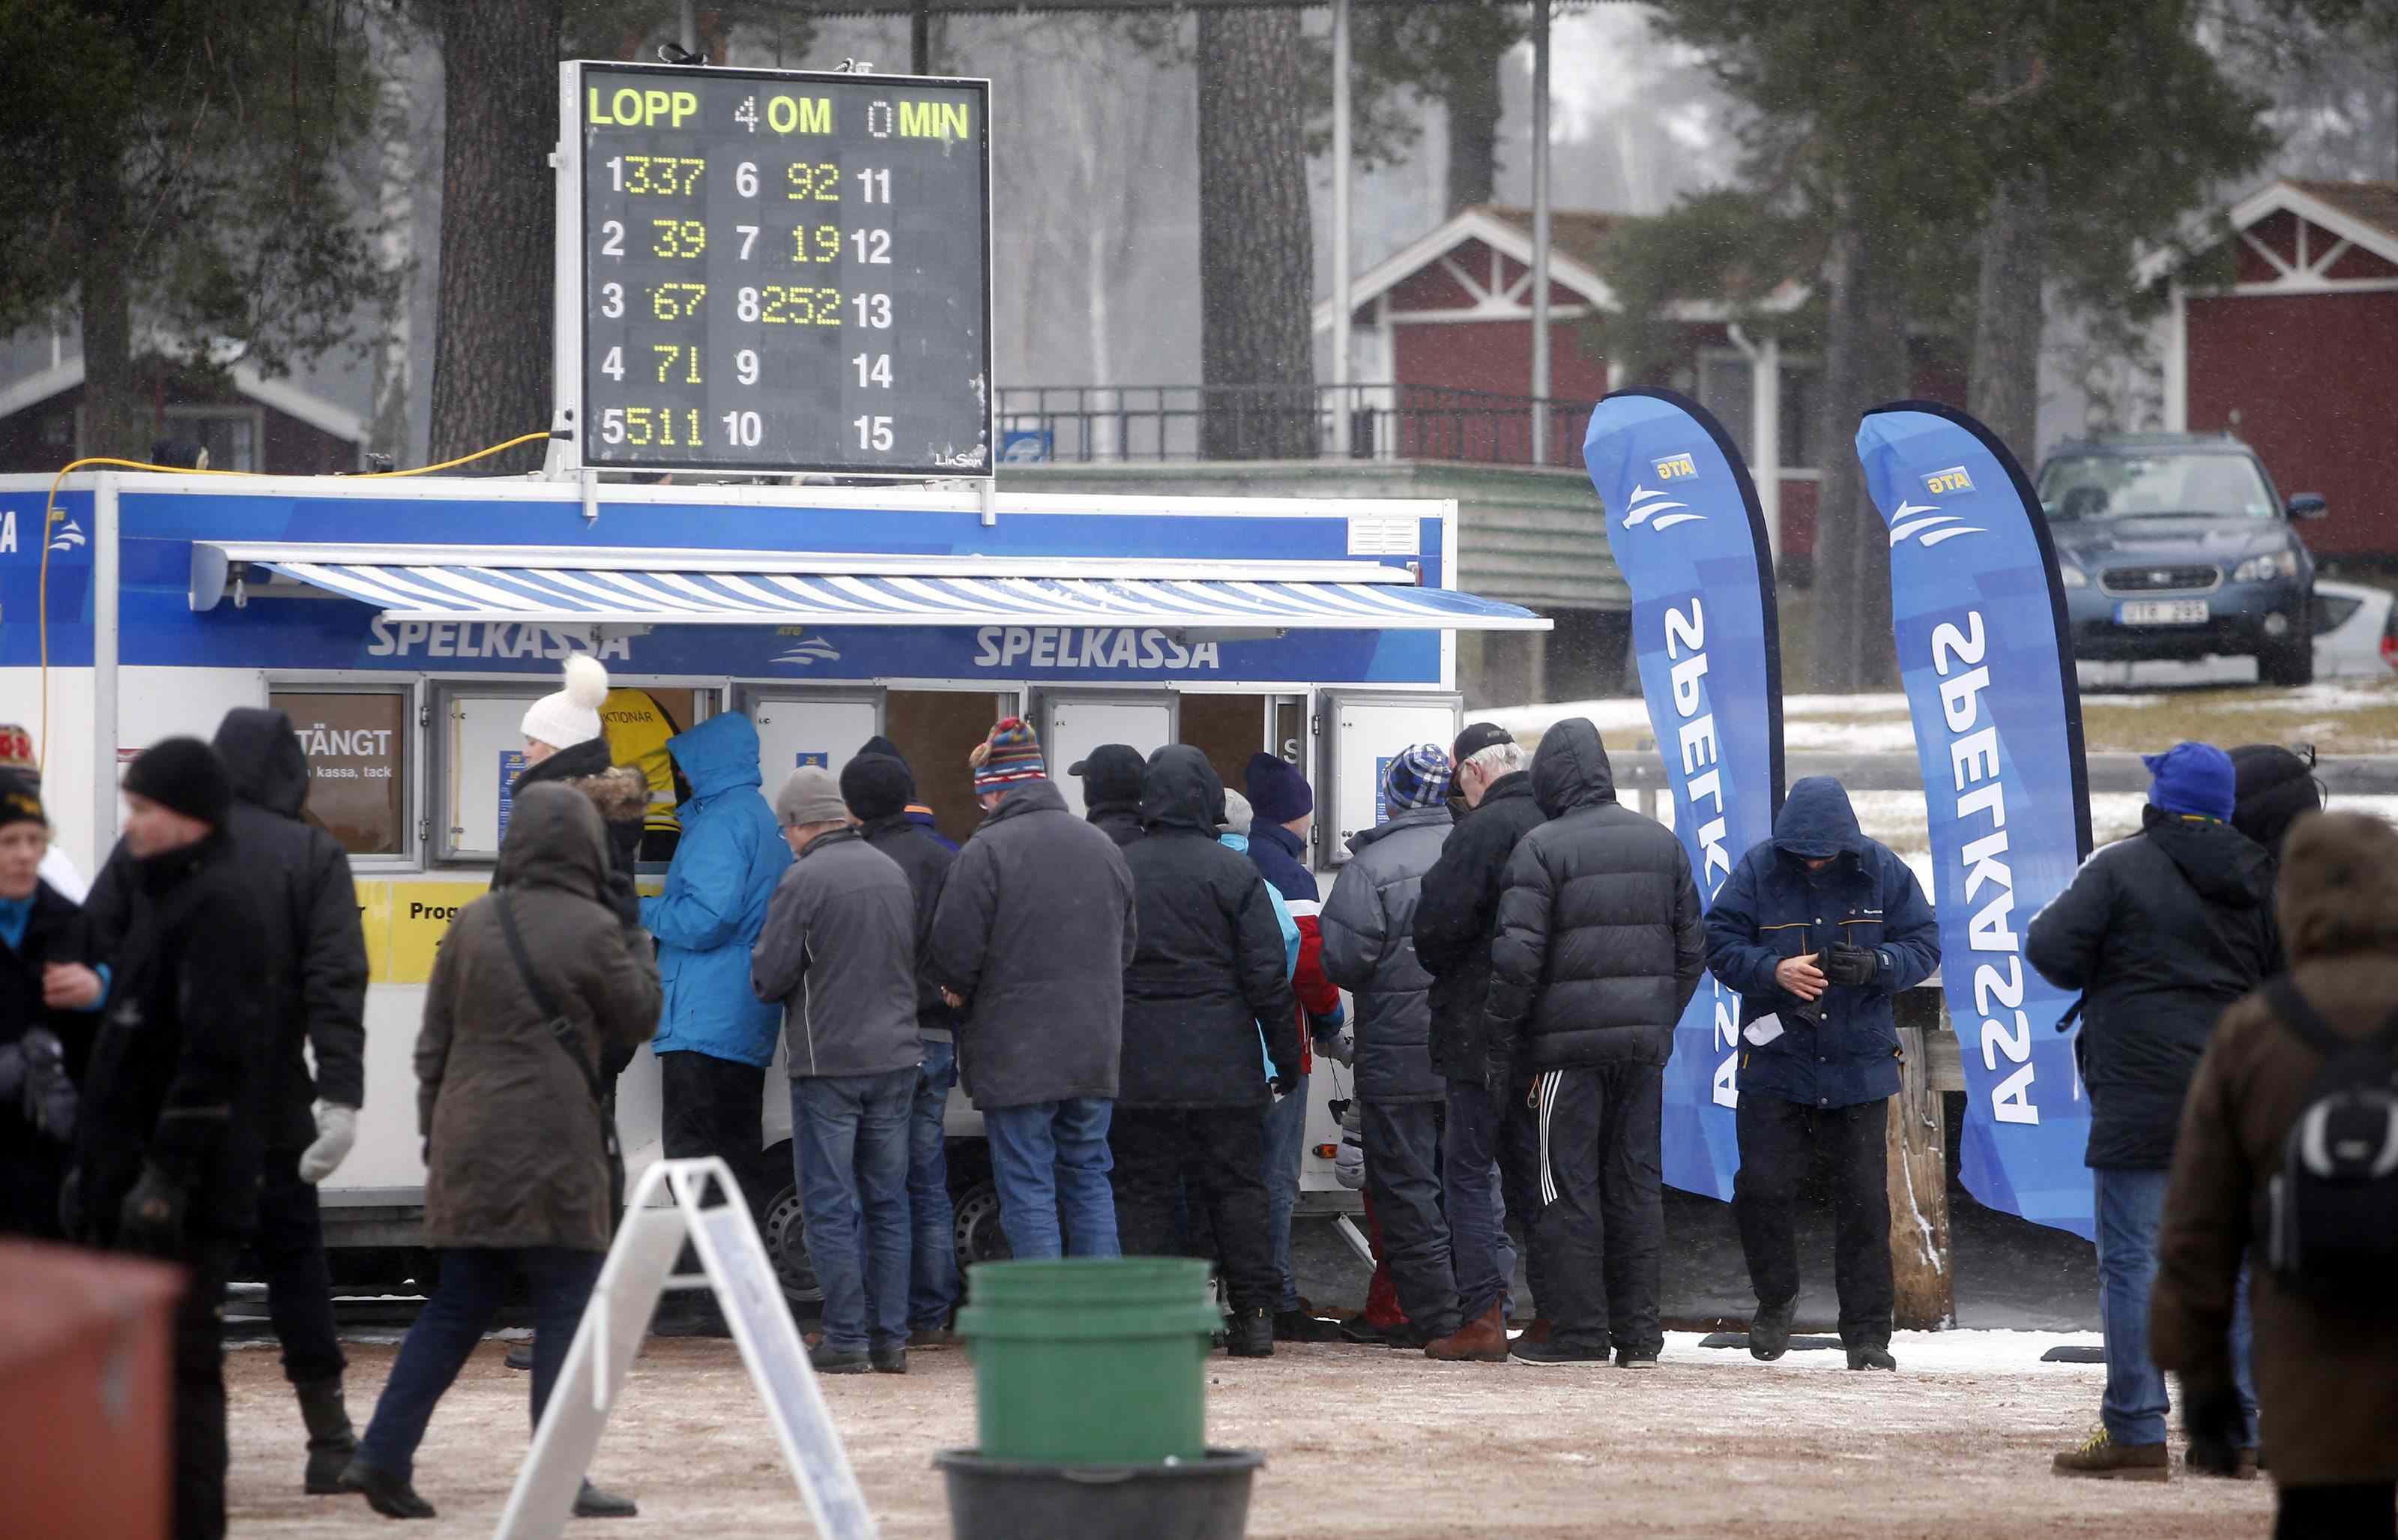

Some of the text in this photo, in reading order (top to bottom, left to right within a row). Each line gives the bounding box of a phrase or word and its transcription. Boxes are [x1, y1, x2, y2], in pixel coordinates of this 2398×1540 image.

[589, 88, 967, 139] LOPP 4 OM 0 MIN
[606, 155, 890, 203] 1 337 6 92 11
[602, 220, 891, 264] 2 39 7 19 12
[602, 283, 892, 328] 3 67 8 252 13
[602, 345, 893, 388] 4 71 9 14
[602, 407, 893, 450] 5 511 10 15
[974, 626, 1219, 669] SPELKASSA
[294, 723, 392, 756] TÄNGT
[317, 766, 358, 779] kassa,
[363, 766, 392, 778] tack
